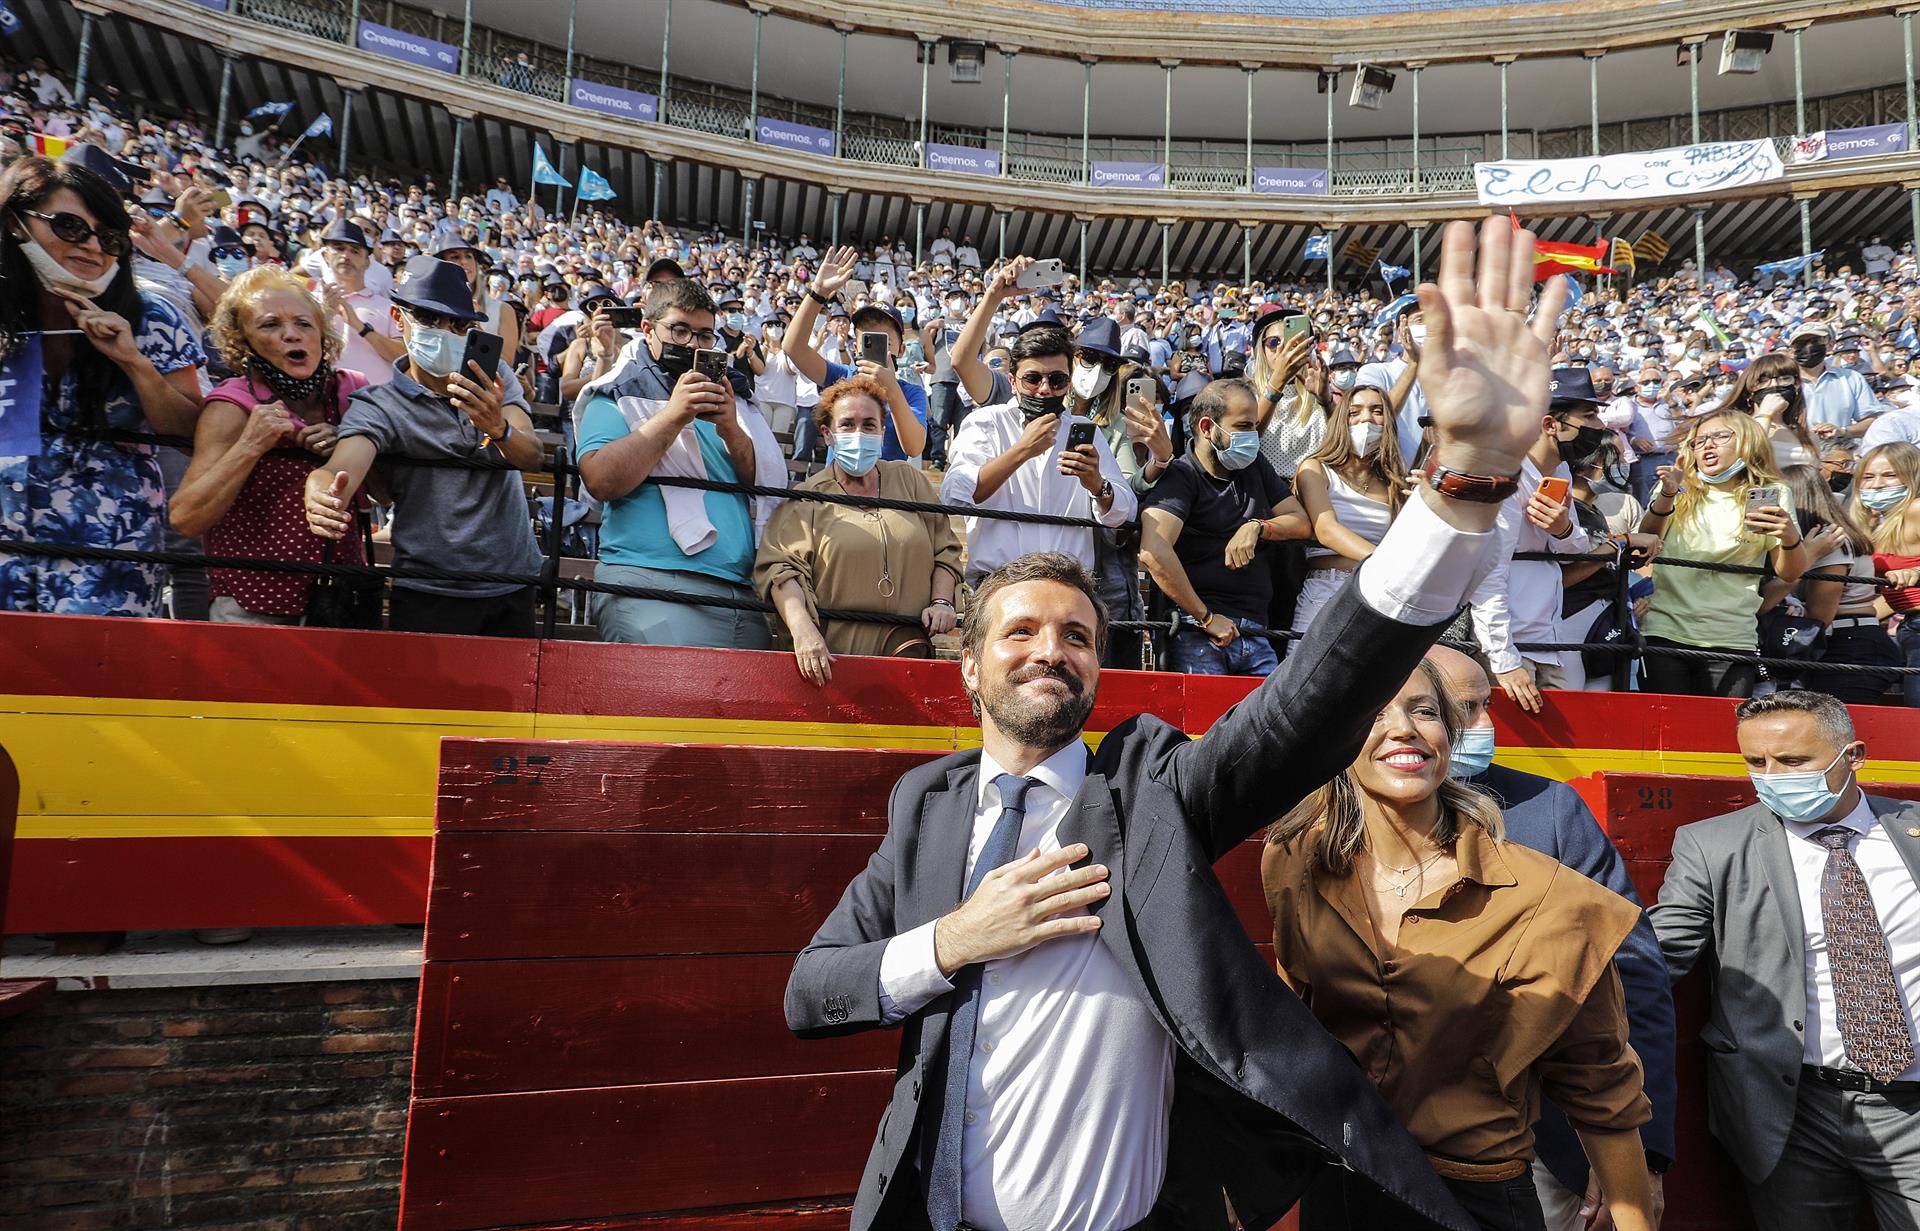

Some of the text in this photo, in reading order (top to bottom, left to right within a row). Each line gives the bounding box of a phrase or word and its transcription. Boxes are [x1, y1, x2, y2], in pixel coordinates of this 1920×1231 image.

[363, 29, 430, 57] Creemos.
[575, 88, 633, 111] Creemos.
[760, 126, 813, 145] Creemos.
[929, 151, 979, 168] Creemos.
[1094, 169, 1143, 182] Creemos.
[1258, 175, 1307, 188] Creemos.
[1638, 786, 1673, 810] 28
